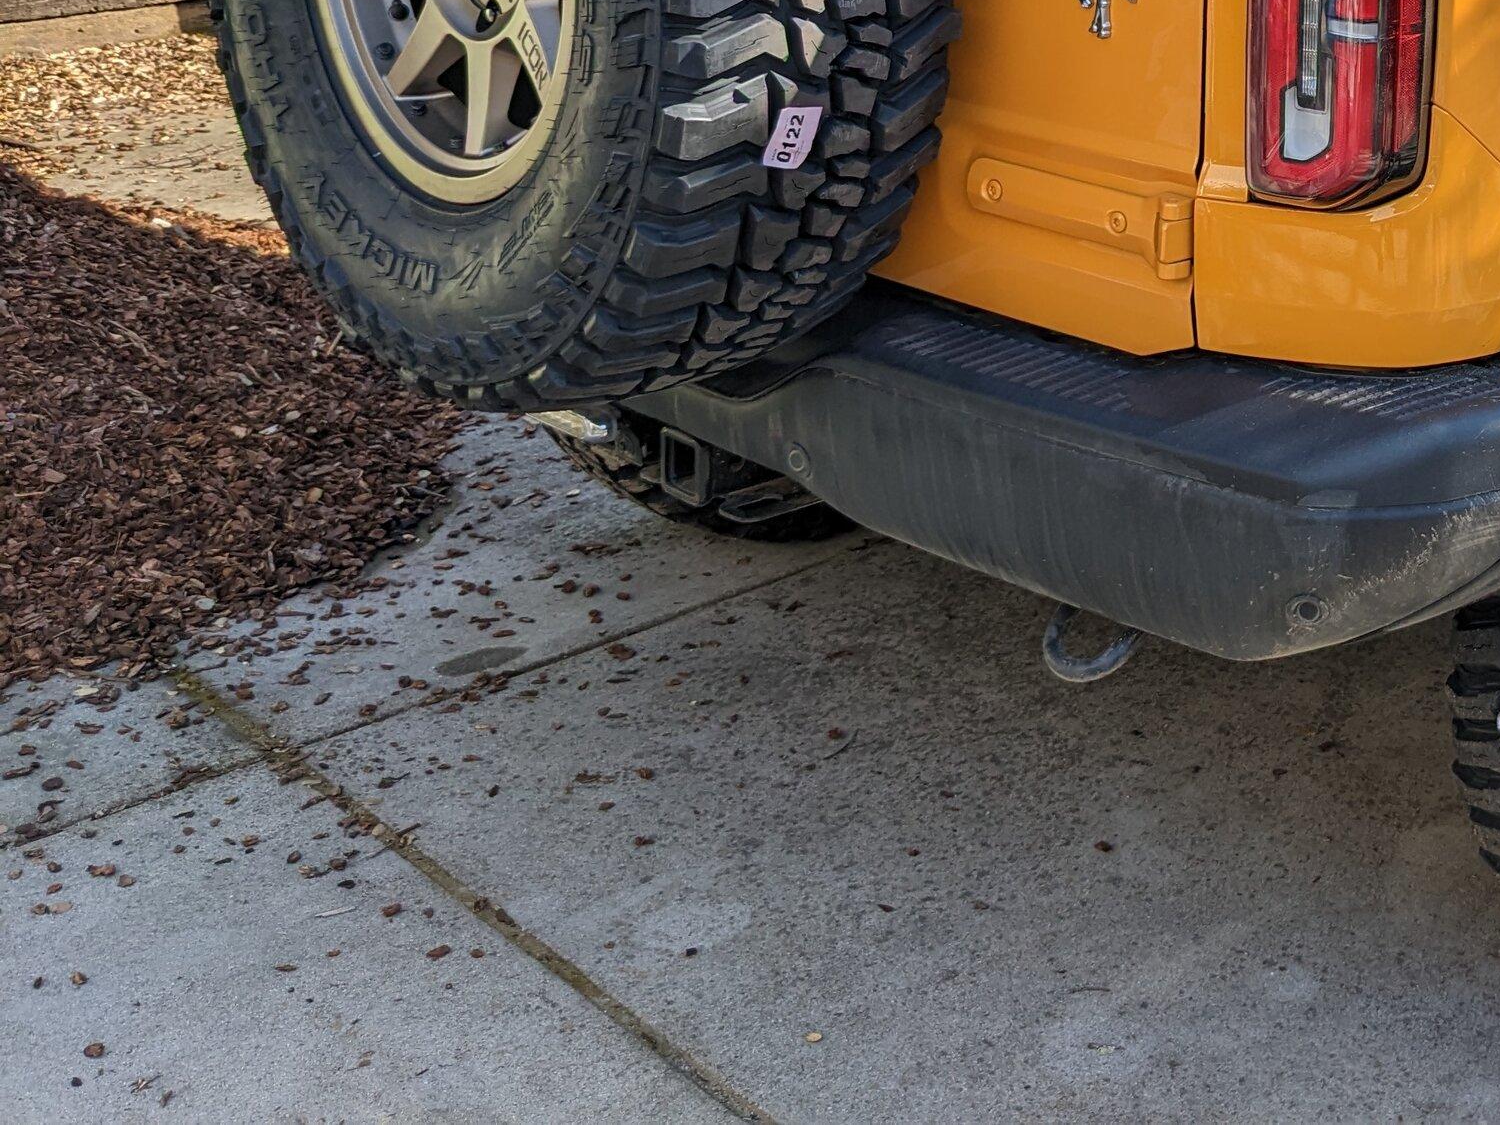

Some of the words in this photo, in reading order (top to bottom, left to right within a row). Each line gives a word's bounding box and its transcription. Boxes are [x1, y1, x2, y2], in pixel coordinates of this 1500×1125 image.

[516, 21, 550, 90] ICON
[776, 114, 805, 163] 0122
[302, 172, 440, 295] MICKEY
